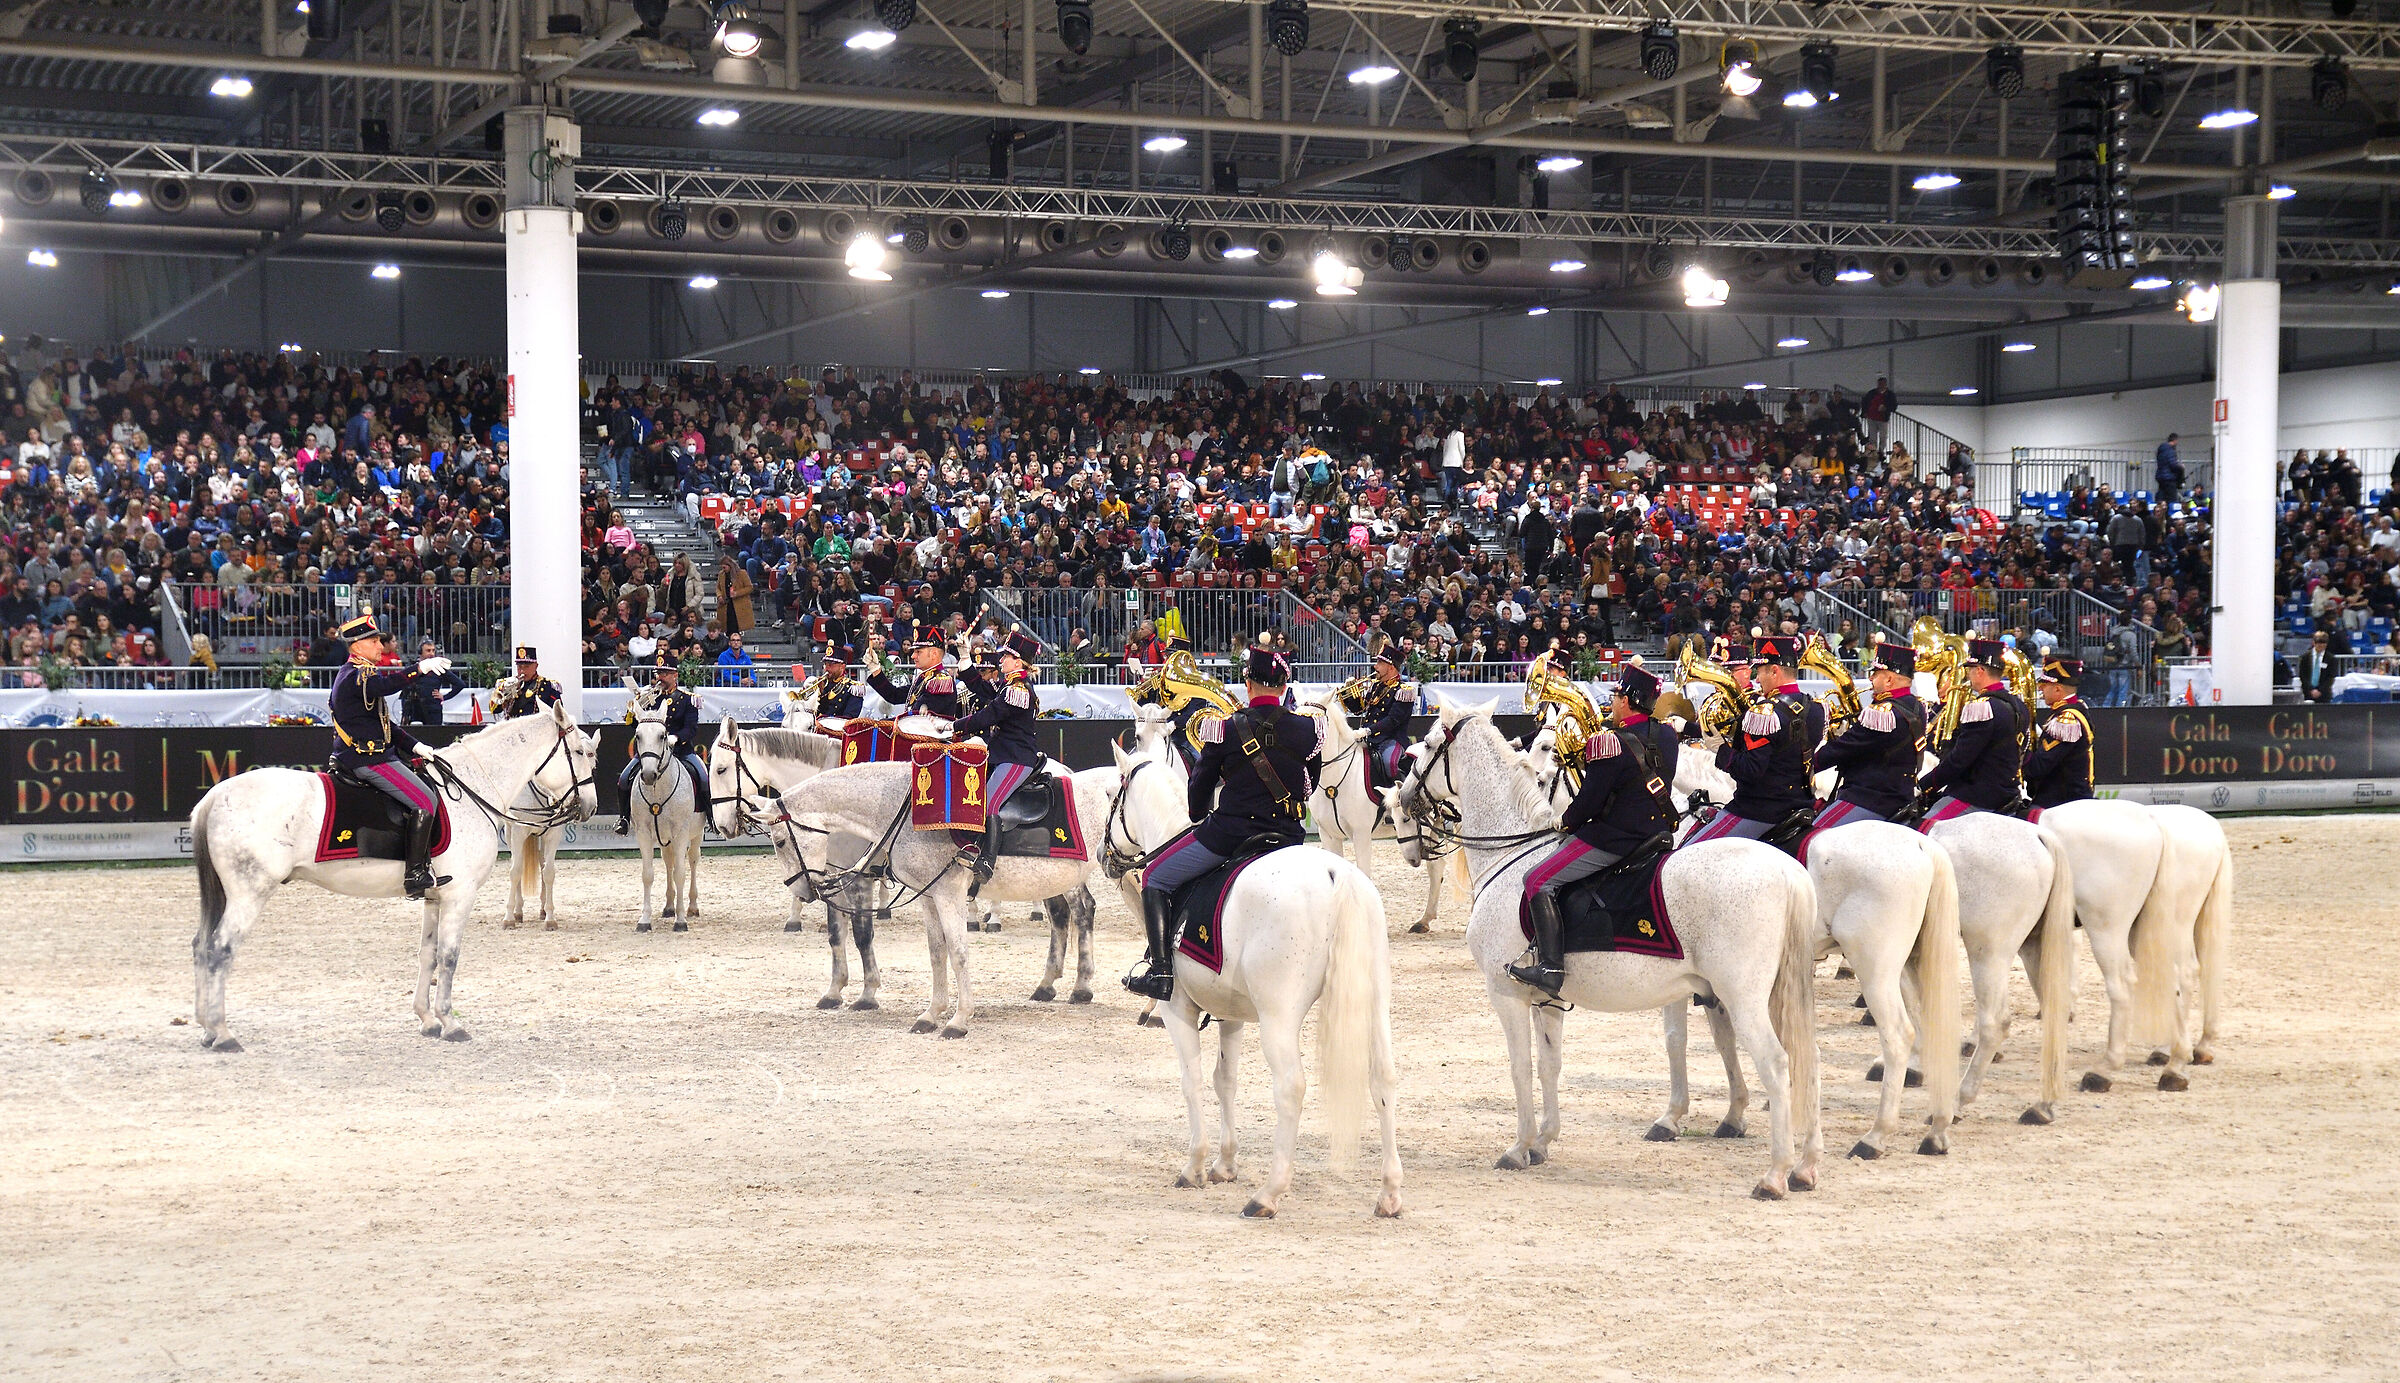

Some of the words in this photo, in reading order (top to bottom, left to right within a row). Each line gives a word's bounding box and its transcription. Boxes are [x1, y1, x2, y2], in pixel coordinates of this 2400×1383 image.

[2170, 713, 2231, 742] Gala
[2268, 711, 2329, 740] Gala
[27, 738, 125, 773] Gala
[2162, 745, 2239, 776] D'oro
[2260, 742, 2336, 774] D'oro
[15, 776, 135, 815] D'oro
[42, 832, 105, 841] SCUDERIA
